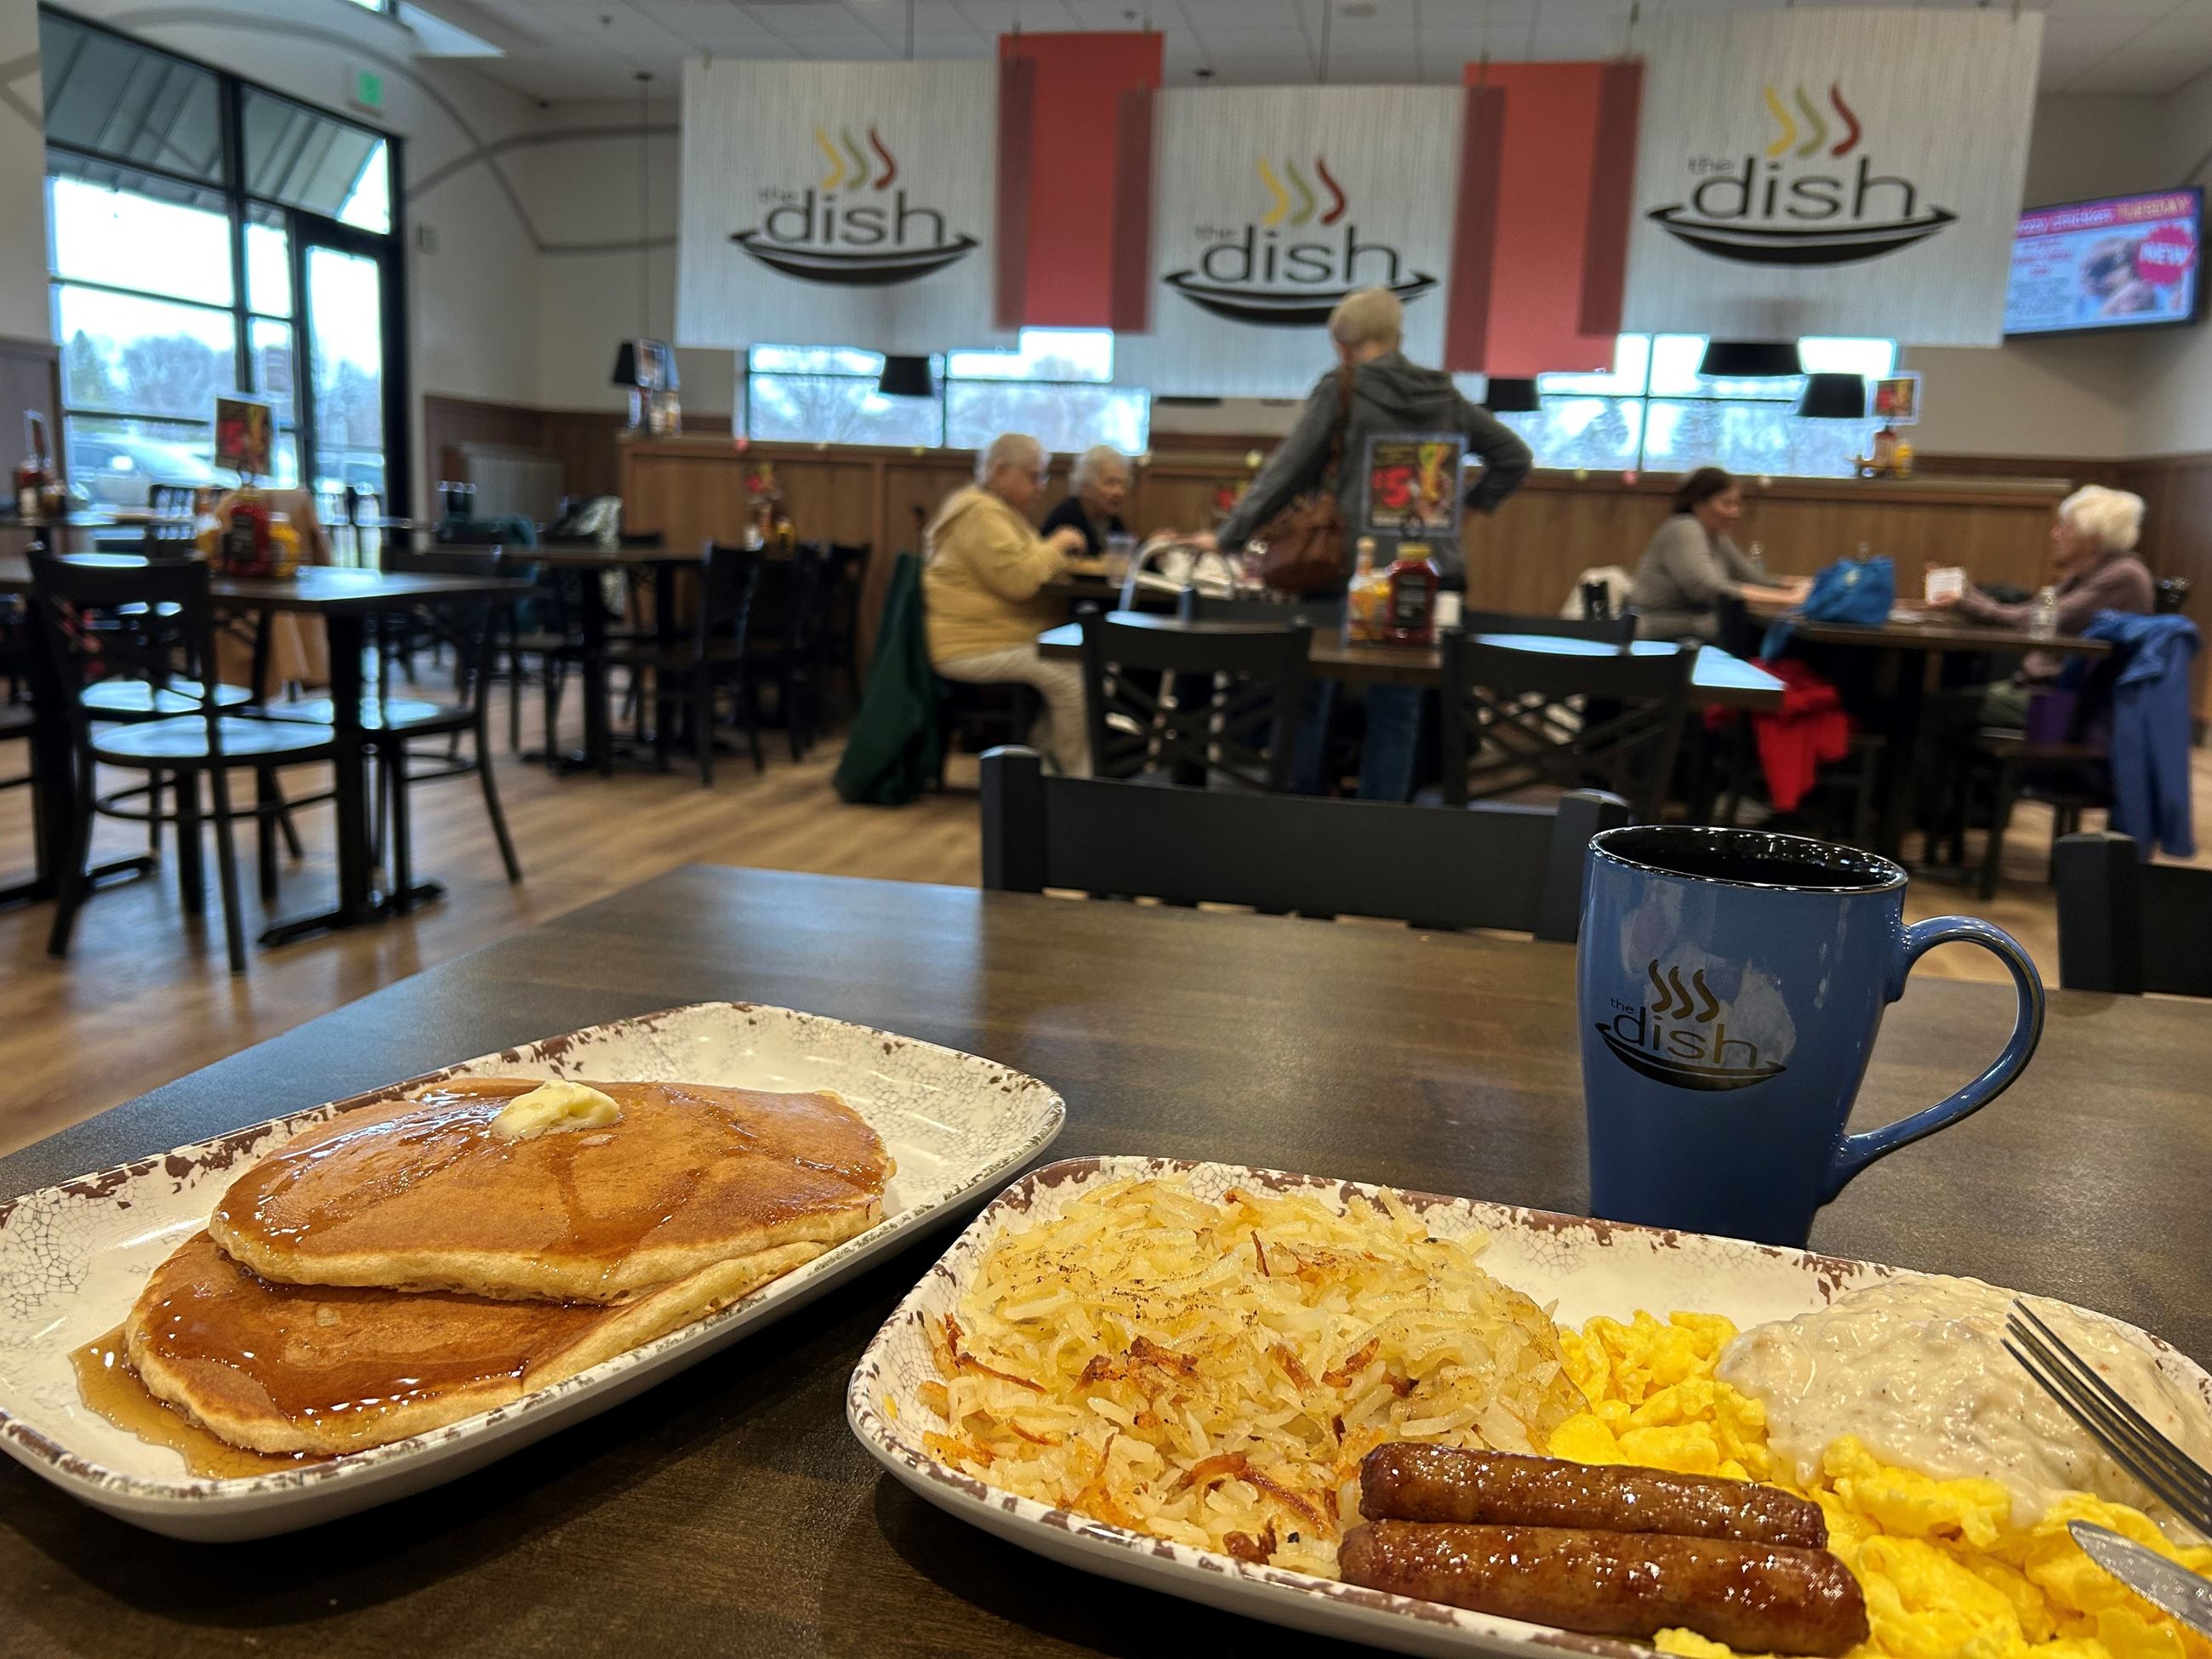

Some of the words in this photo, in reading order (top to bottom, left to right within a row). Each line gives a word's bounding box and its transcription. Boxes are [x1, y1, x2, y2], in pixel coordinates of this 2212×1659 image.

[1688, 156, 1735, 174] the
[1692, 155, 1915, 219] dish
[767, 188, 944, 245] dish
[1203, 225, 1398, 285] dish
[1609, 997, 1634, 1014] the
[1613, 1006, 1758, 1069] dish
